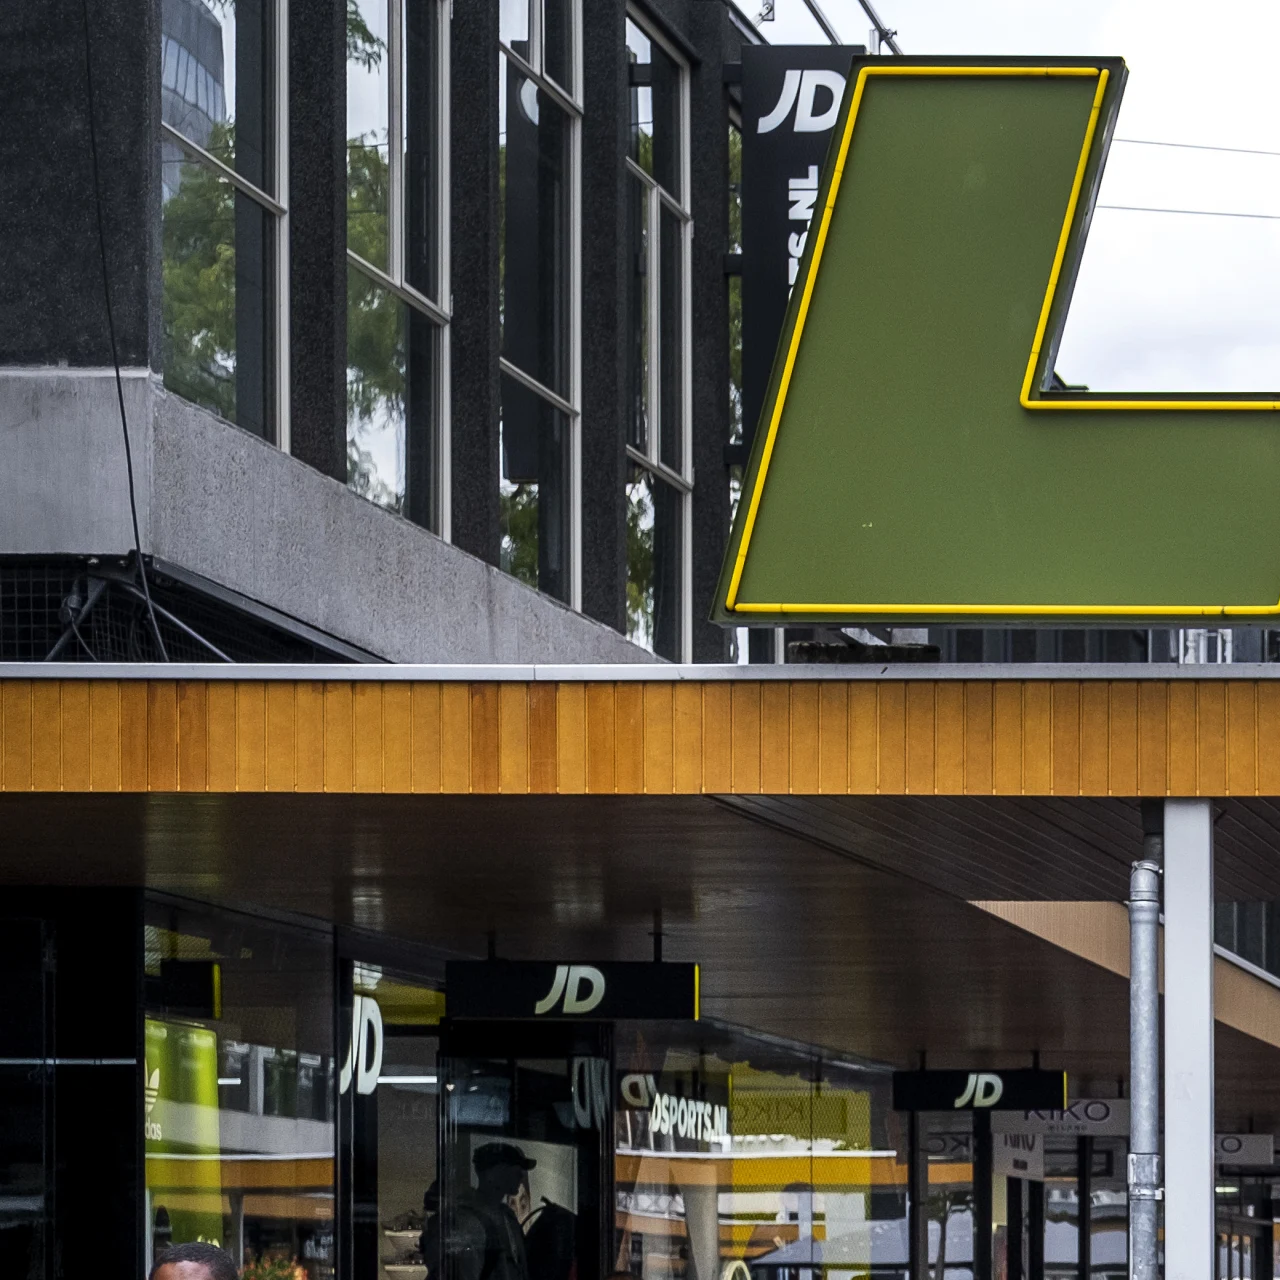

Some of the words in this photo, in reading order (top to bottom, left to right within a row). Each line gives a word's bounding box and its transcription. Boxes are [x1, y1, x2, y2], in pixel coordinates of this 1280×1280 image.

[757, 69, 847, 134] JD
[534, 964, 606, 1015] JD
[339, 994, 384, 1095] JD
[953, 1072, 1003, 1109] JD
[648, 1092, 728, 1142] DSPORTS.NL
